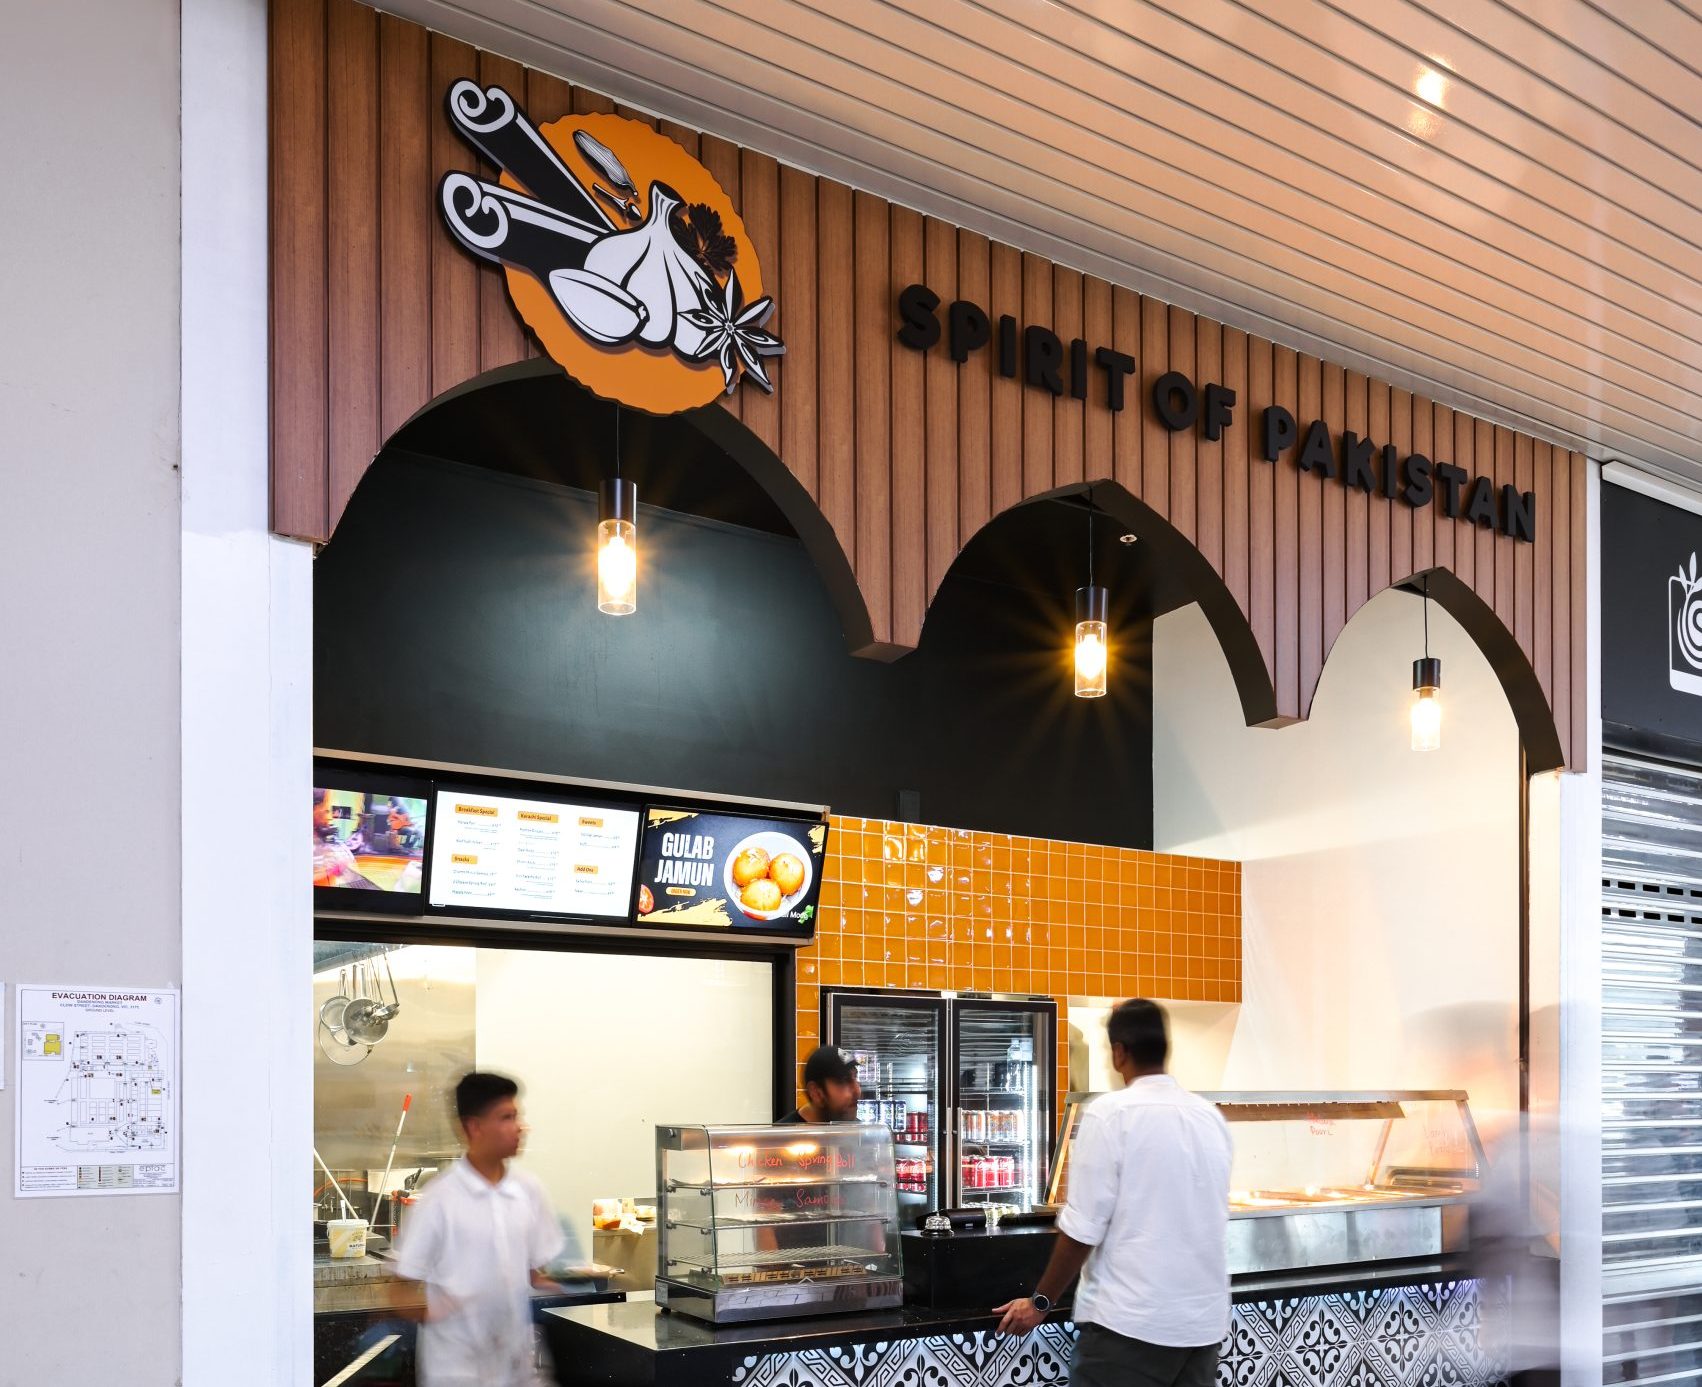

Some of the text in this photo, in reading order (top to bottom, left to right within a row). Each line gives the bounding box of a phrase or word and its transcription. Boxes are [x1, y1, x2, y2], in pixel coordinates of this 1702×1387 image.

[897, 284, 1535, 543] SPIRIT OF PAKISTAN
[661, 832, 715, 860] GULAB
[654, 859, 715, 886] JAMUN
[52, 992, 147, 1002] EVACUATION DIAGRAM
[739, 1151, 783, 1169] Chicken
[799, 1151, 832, 1173] Spring
